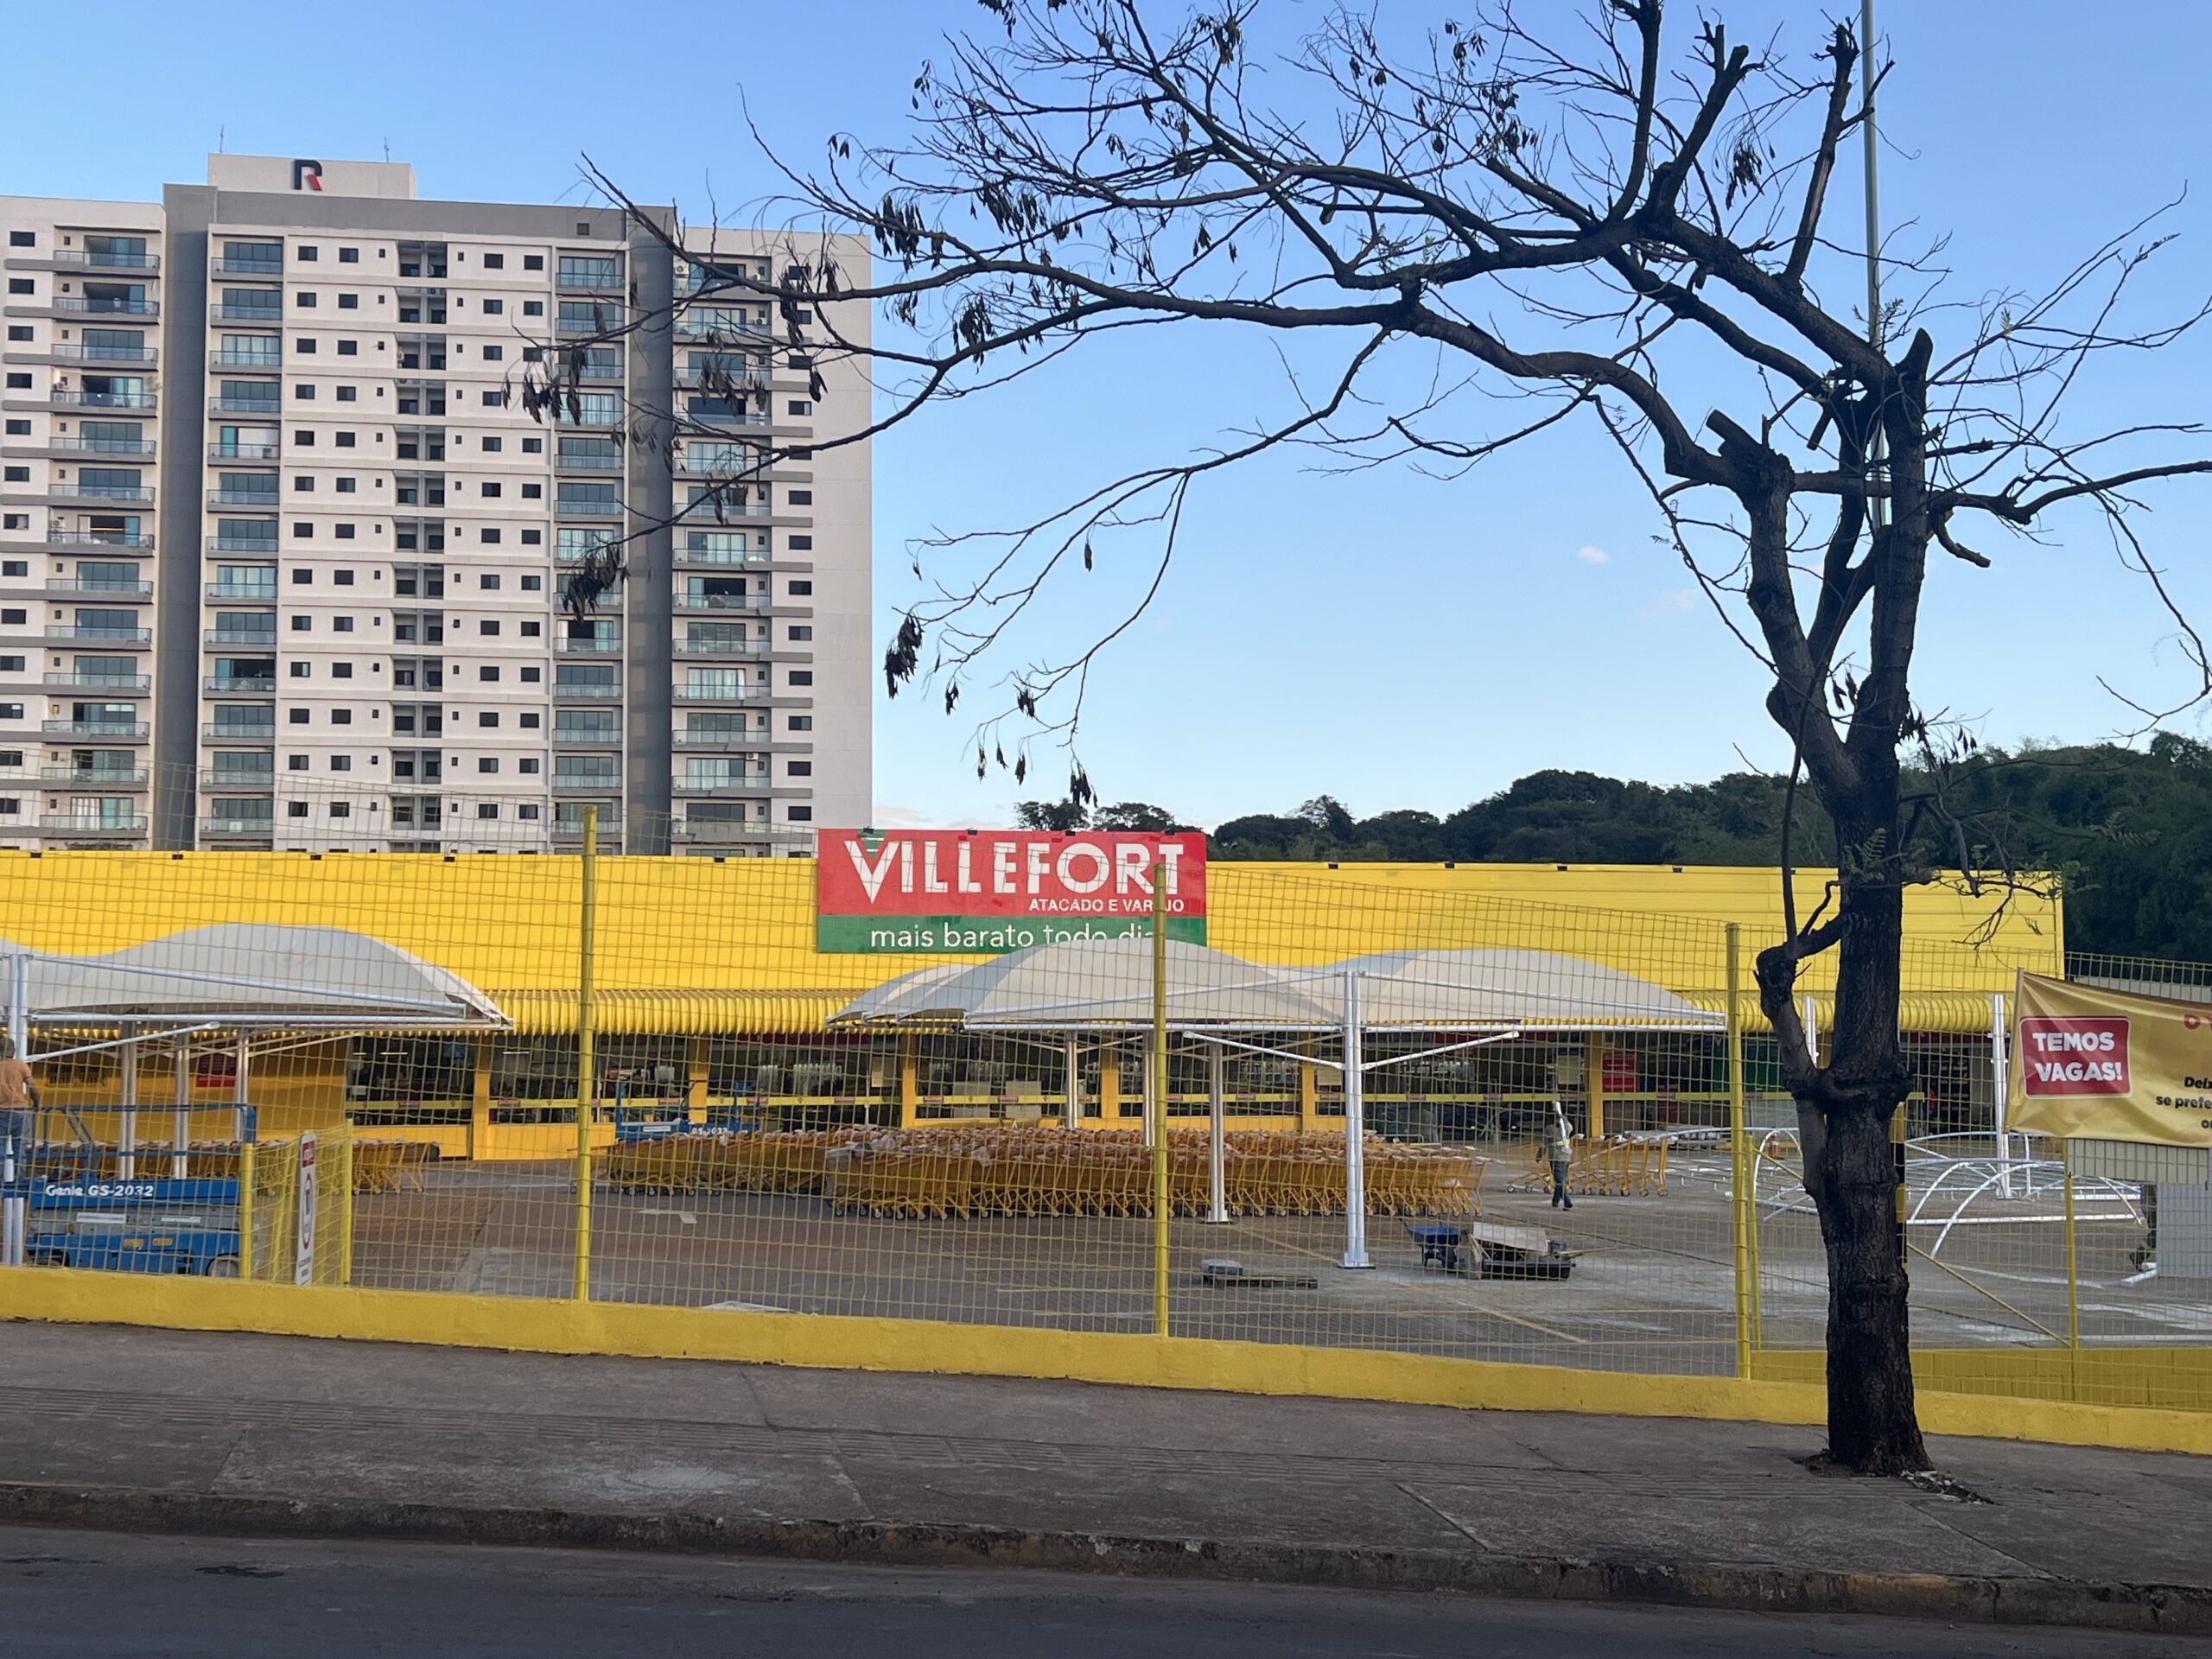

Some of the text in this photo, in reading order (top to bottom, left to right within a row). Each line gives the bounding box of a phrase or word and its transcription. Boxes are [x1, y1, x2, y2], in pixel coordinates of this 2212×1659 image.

[294, 159, 322, 192] R
[843, 839, 1184, 905] VILLEFORT
[1029, 898, 1185, 912] ATACADO E VARJO
[870, 924, 934, 948] mais
[944, 921, 1034, 948] barato
[2032, 1032, 2114, 1052] TEMOS
[2034, 1061, 2123, 1083] VAGAS!
[2156, 1095, 2171, 1106] se
[45, 1184, 154, 1197] Genie GS-2032
